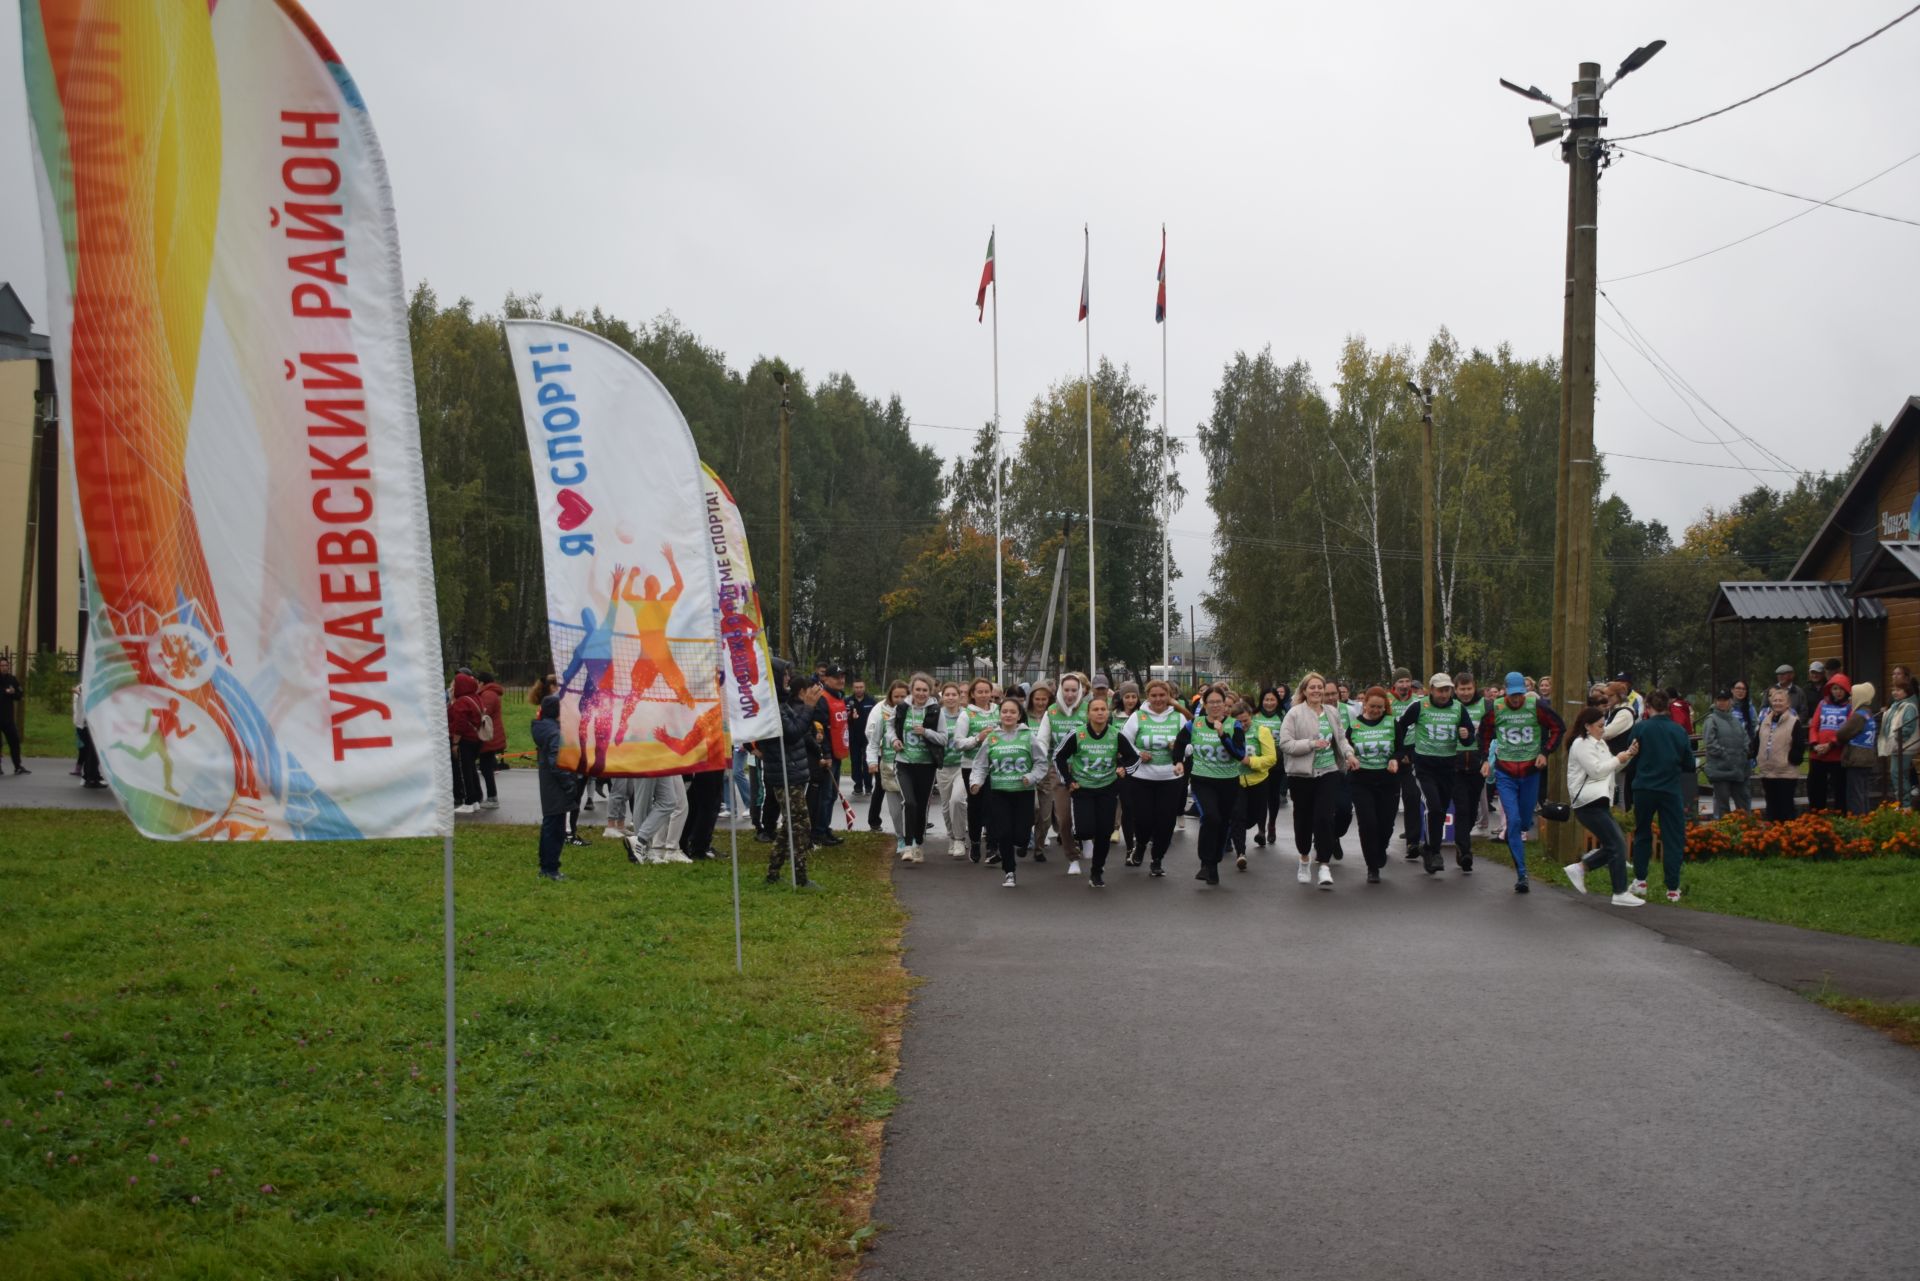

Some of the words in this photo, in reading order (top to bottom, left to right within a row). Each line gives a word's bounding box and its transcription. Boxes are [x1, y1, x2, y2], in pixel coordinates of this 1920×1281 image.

[270, 111, 352, 318] РАЙОН
[529, 343, 588, 486] СПОРТ!
[559, 533, 596, 557] Я
[705, 491, 728, 557] СПОРТА!
[285, 353, 393, 761] ТУКАЕВСКИЙ
[717, 558, 738, 611] РИТМЕ
[1192, 744, 1231, 762] 128
[1355, 739, 1392, 757] 133
[1498, 725, 1534, 745] 168
